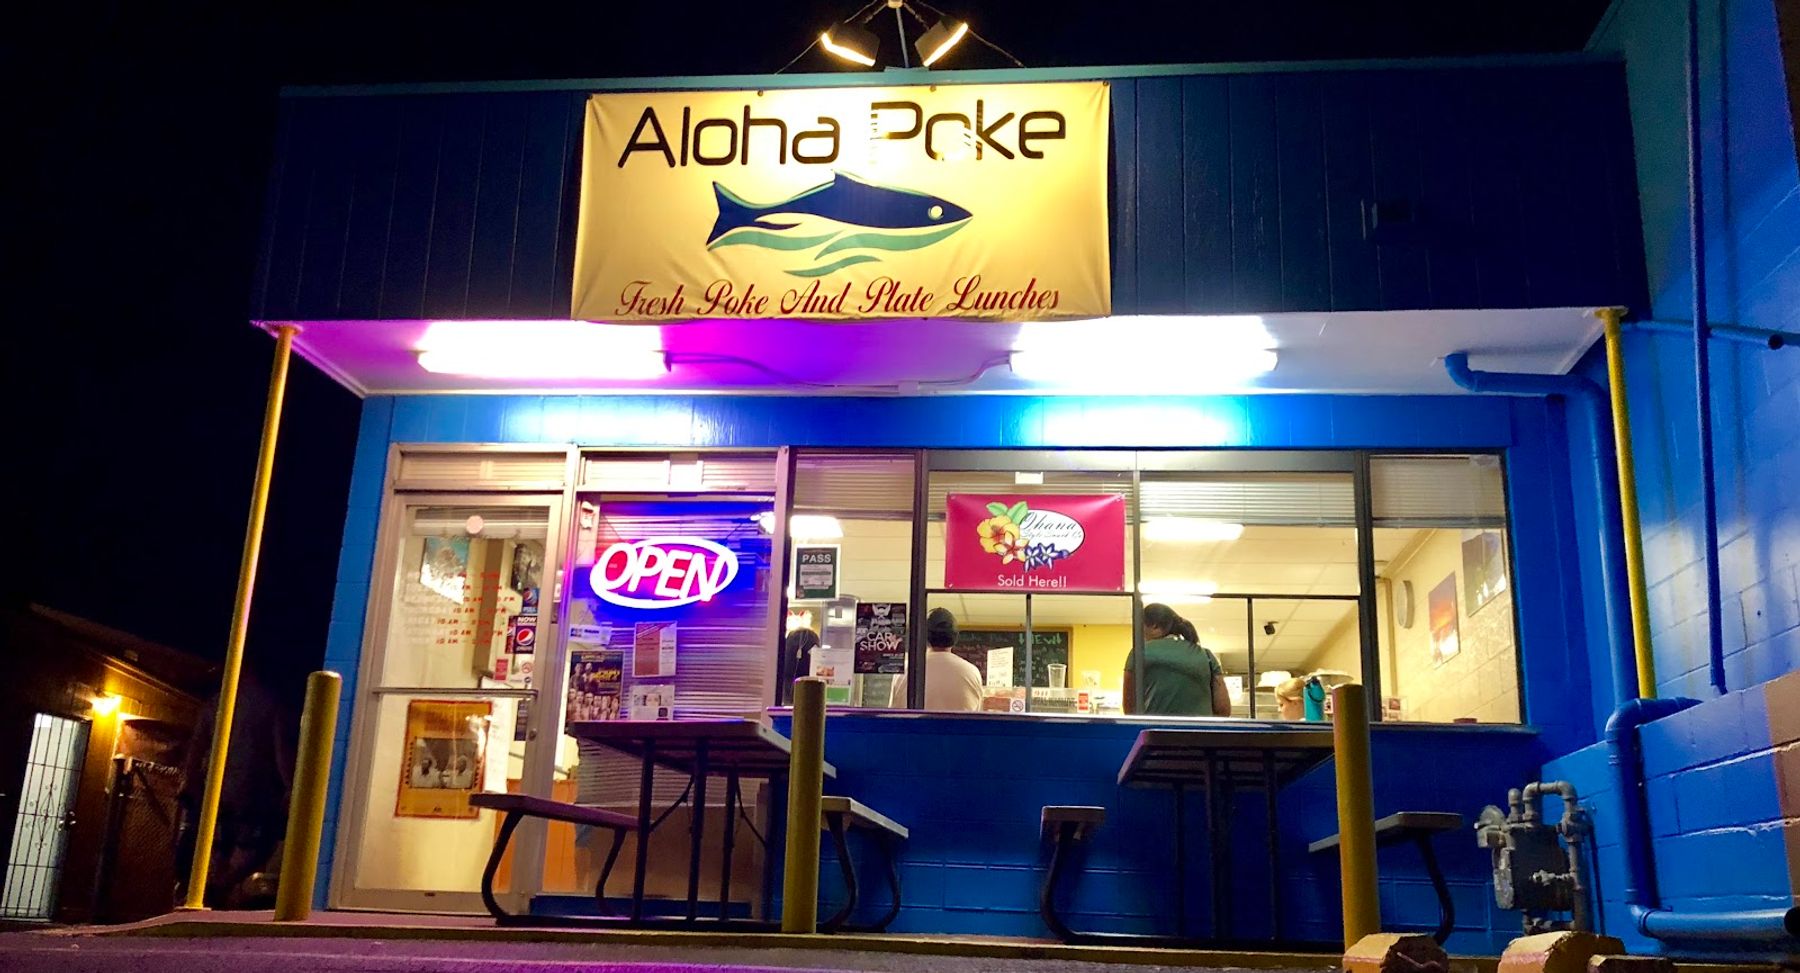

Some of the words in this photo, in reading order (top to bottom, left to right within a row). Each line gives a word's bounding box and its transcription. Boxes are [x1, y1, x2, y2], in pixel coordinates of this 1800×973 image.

[617, 104, 841, 168] Aloha
[870, 99, 1066, 164] Poke
[615, 280, 684, 316] Fresh
[697, 279, 769, 315] Poke
[780, 279, 852, 315] And
[858, 276, 934, 313] Plate
[946, 274, 1060, 311] Lunches
[1019, 511, 1077, 530] Ohana
[802, 554, 832, 564] PASS
[600, 543, 728, 602] OPEN
[997, 574, 1024, 587] Sold
[1028, 575, 1067, 588] Here!!
[866, 632, 893, 641] CAR
[860, 640, 900, 652] SHOW
